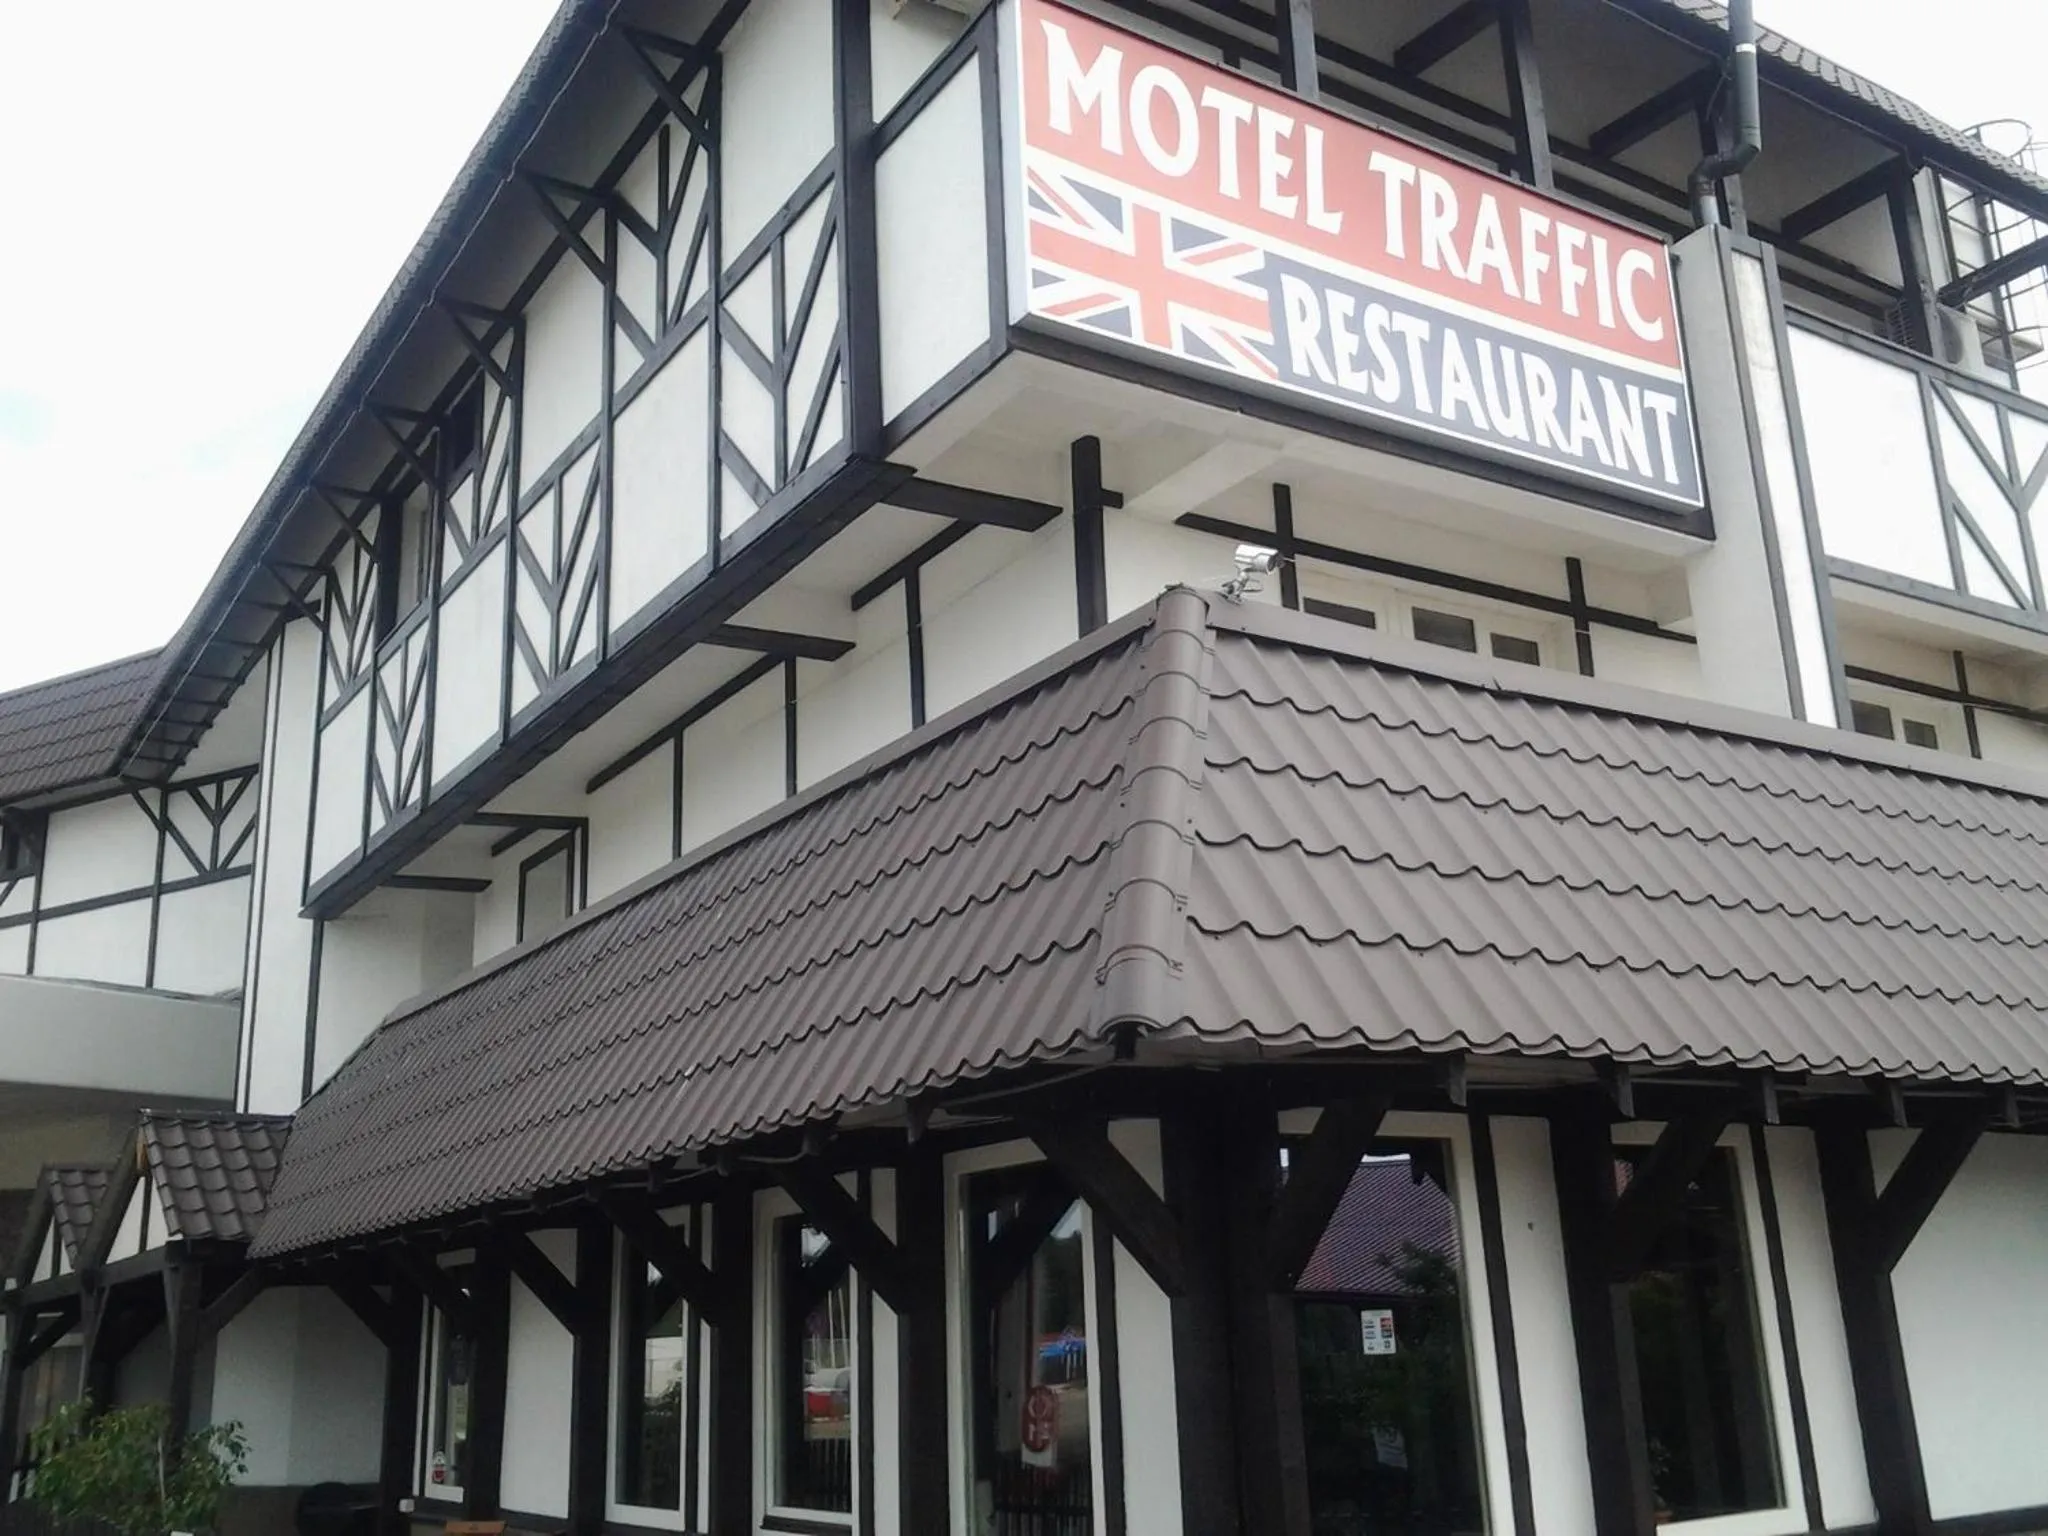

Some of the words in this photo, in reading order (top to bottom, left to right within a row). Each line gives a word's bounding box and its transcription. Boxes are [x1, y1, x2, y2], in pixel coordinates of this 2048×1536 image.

[1041, 19, 1343, 234] MOTEL
[1369, 149, 1665, 342] TRAFFIC
[1280, 274, 1681, 484] RESTAURANT
